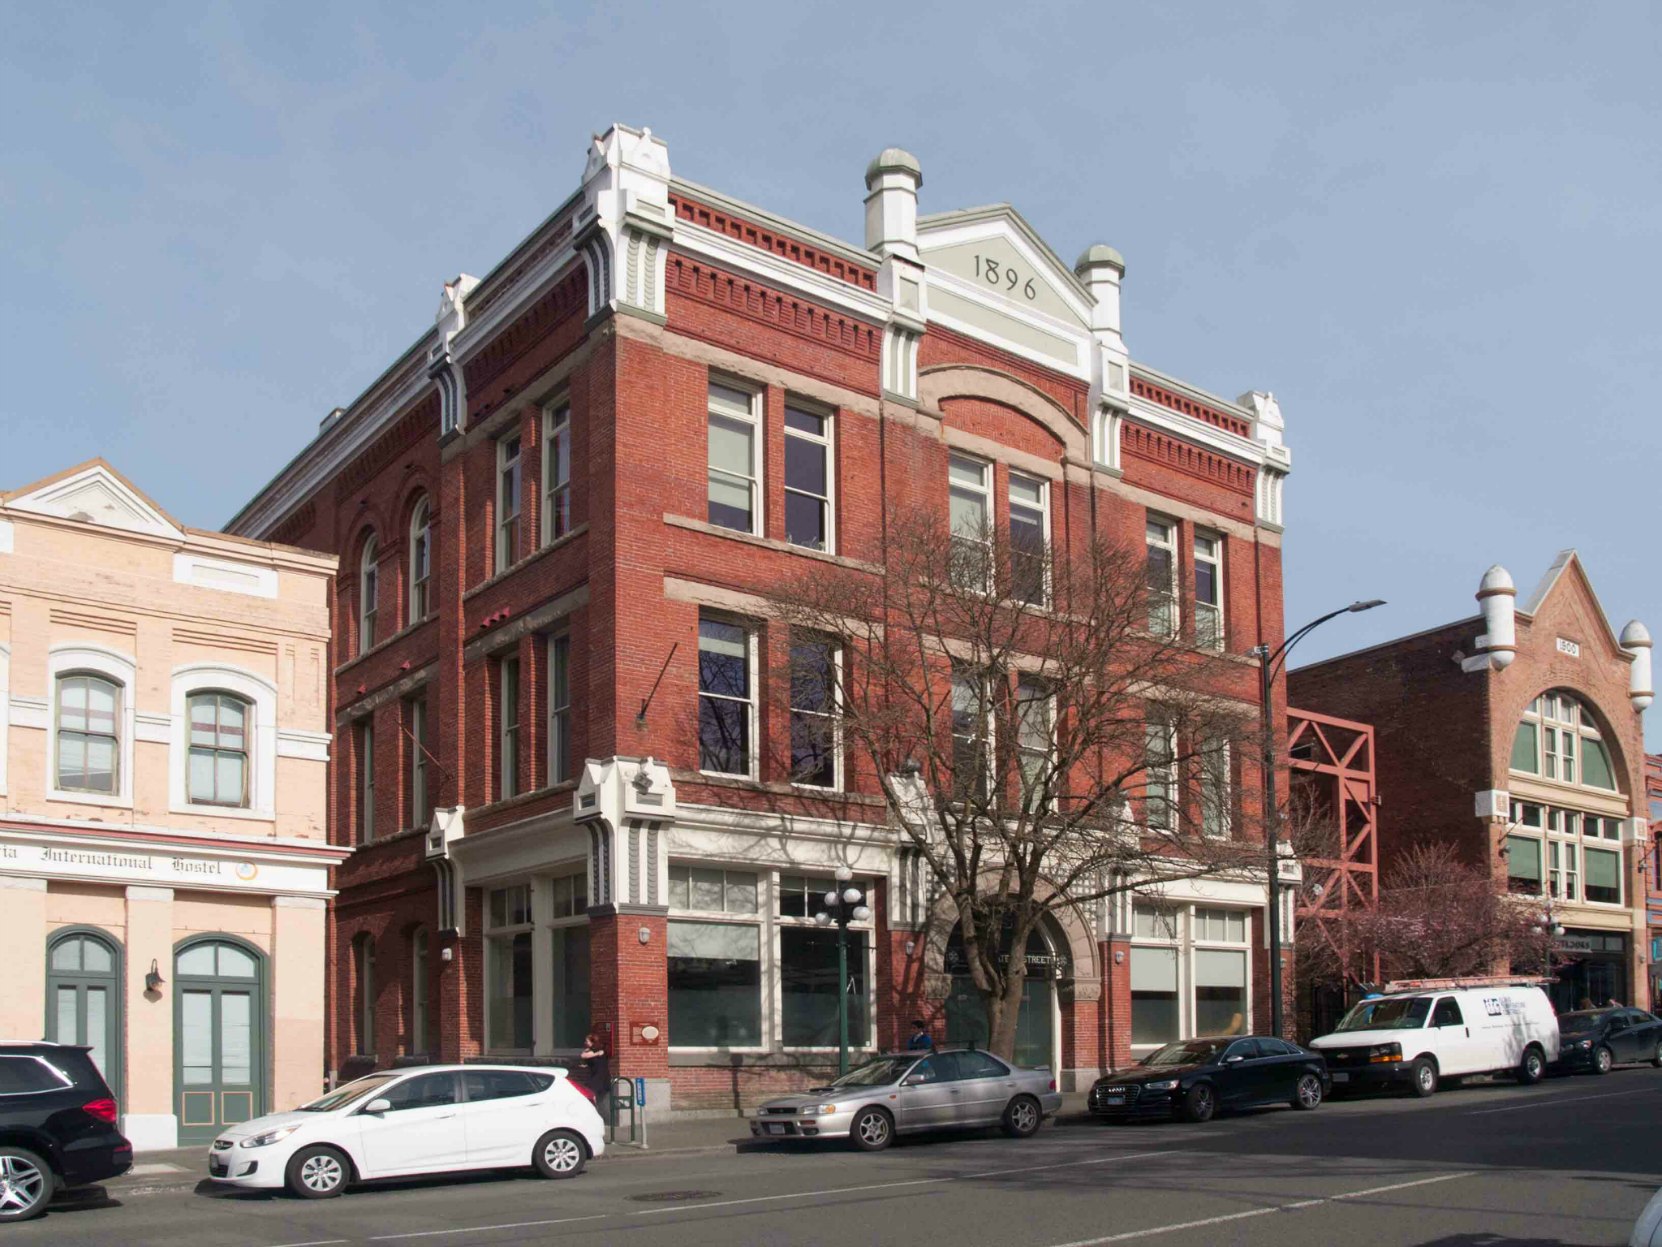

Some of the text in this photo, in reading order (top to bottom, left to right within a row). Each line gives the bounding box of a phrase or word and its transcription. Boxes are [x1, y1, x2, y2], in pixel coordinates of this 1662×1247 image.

[974, 254, 1036, 300] 1896
[40, 846, 153, 870] International
[171, 856, 222, 875] Hostel
